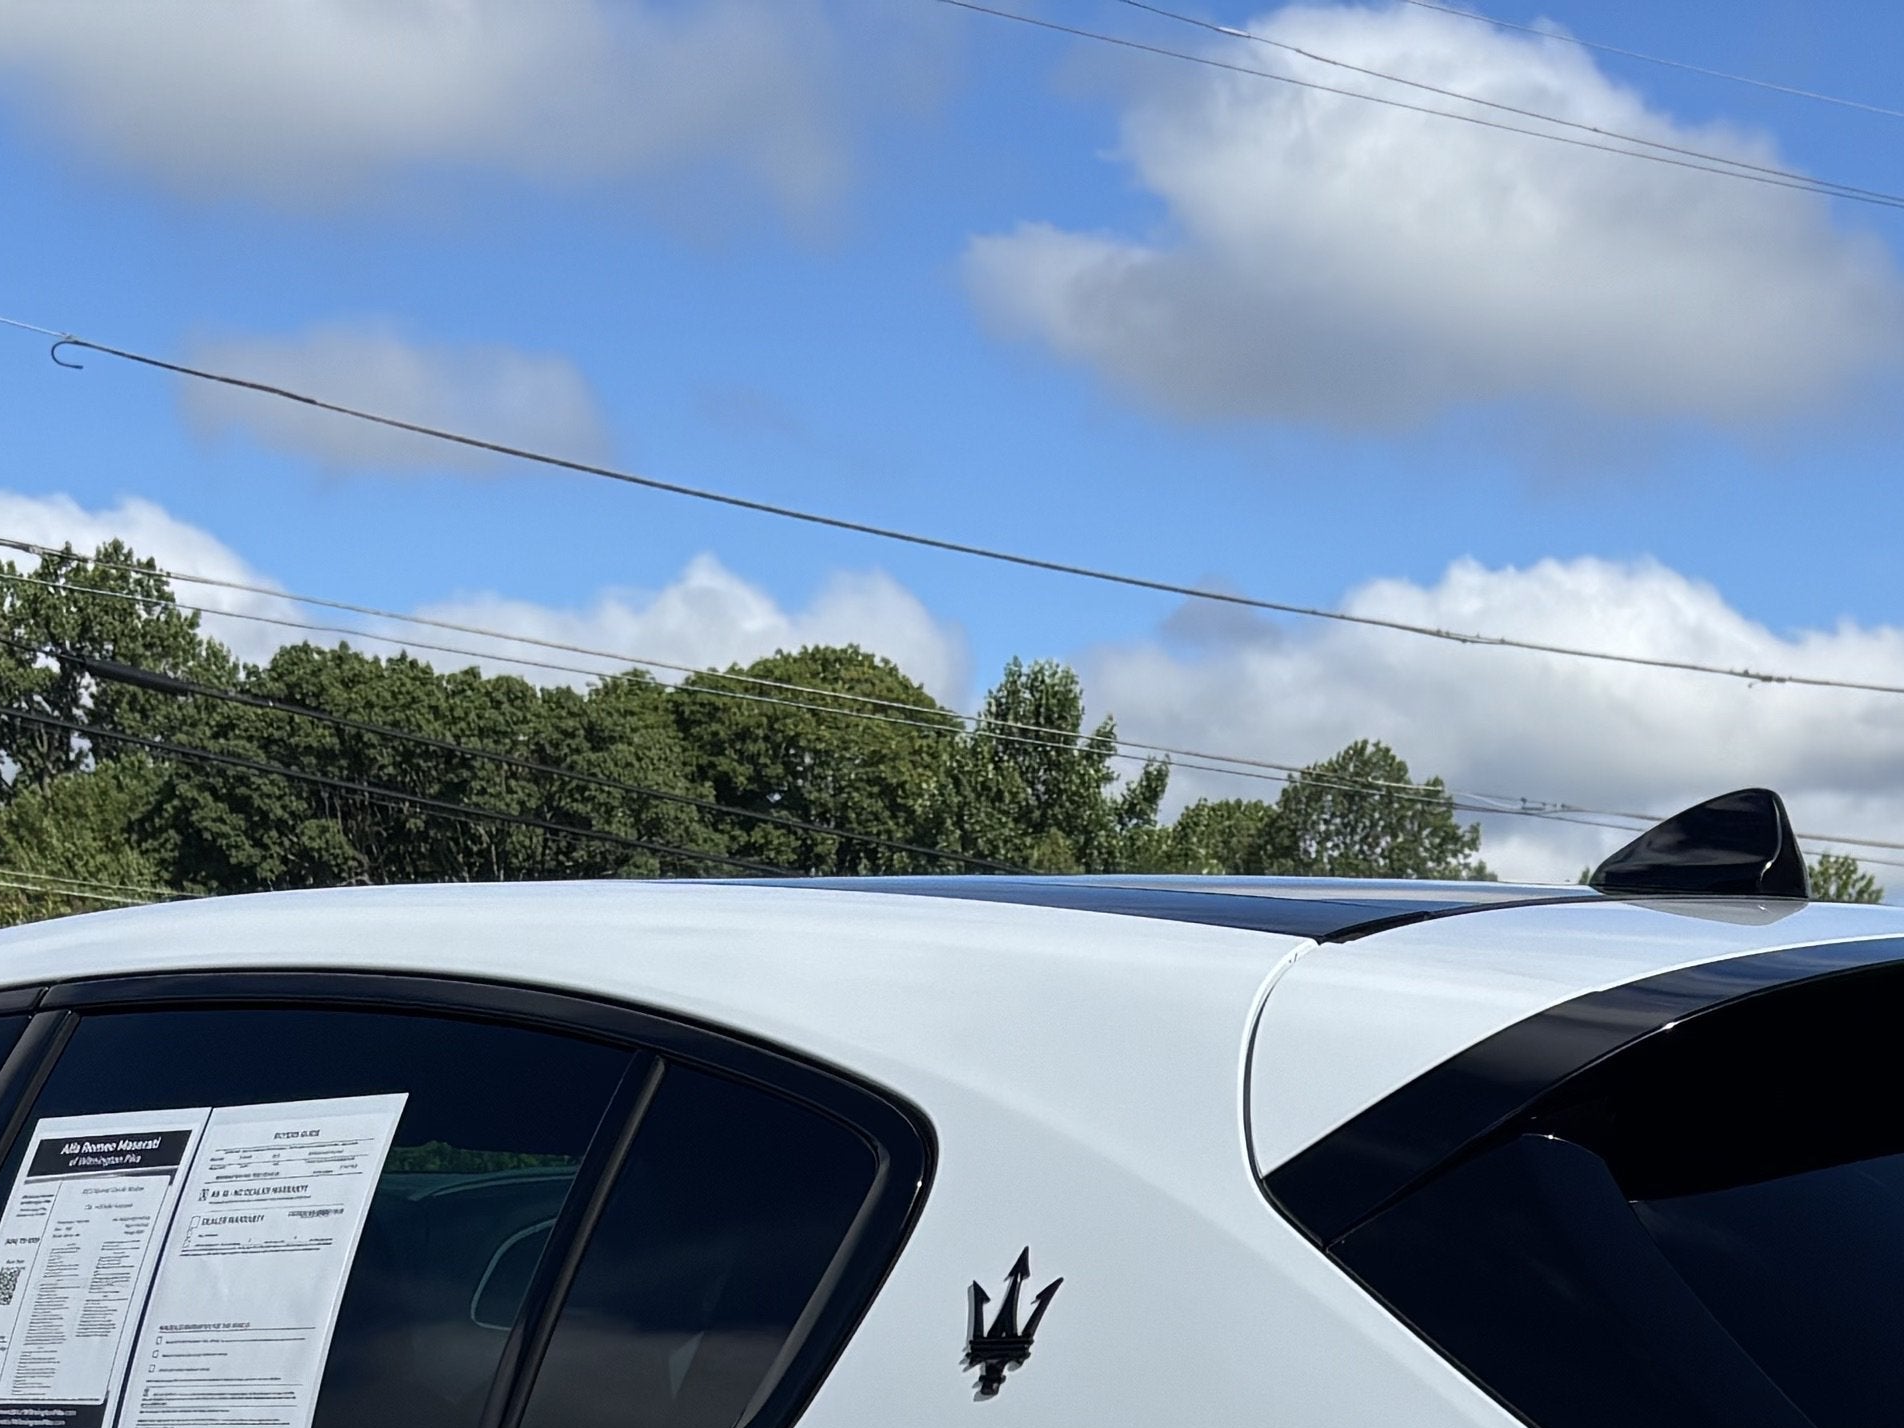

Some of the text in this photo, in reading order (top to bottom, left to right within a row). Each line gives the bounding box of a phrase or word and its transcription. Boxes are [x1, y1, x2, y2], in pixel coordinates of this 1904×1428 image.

[60, 1136, 162, 1155] Alfa Romeo Maserati
